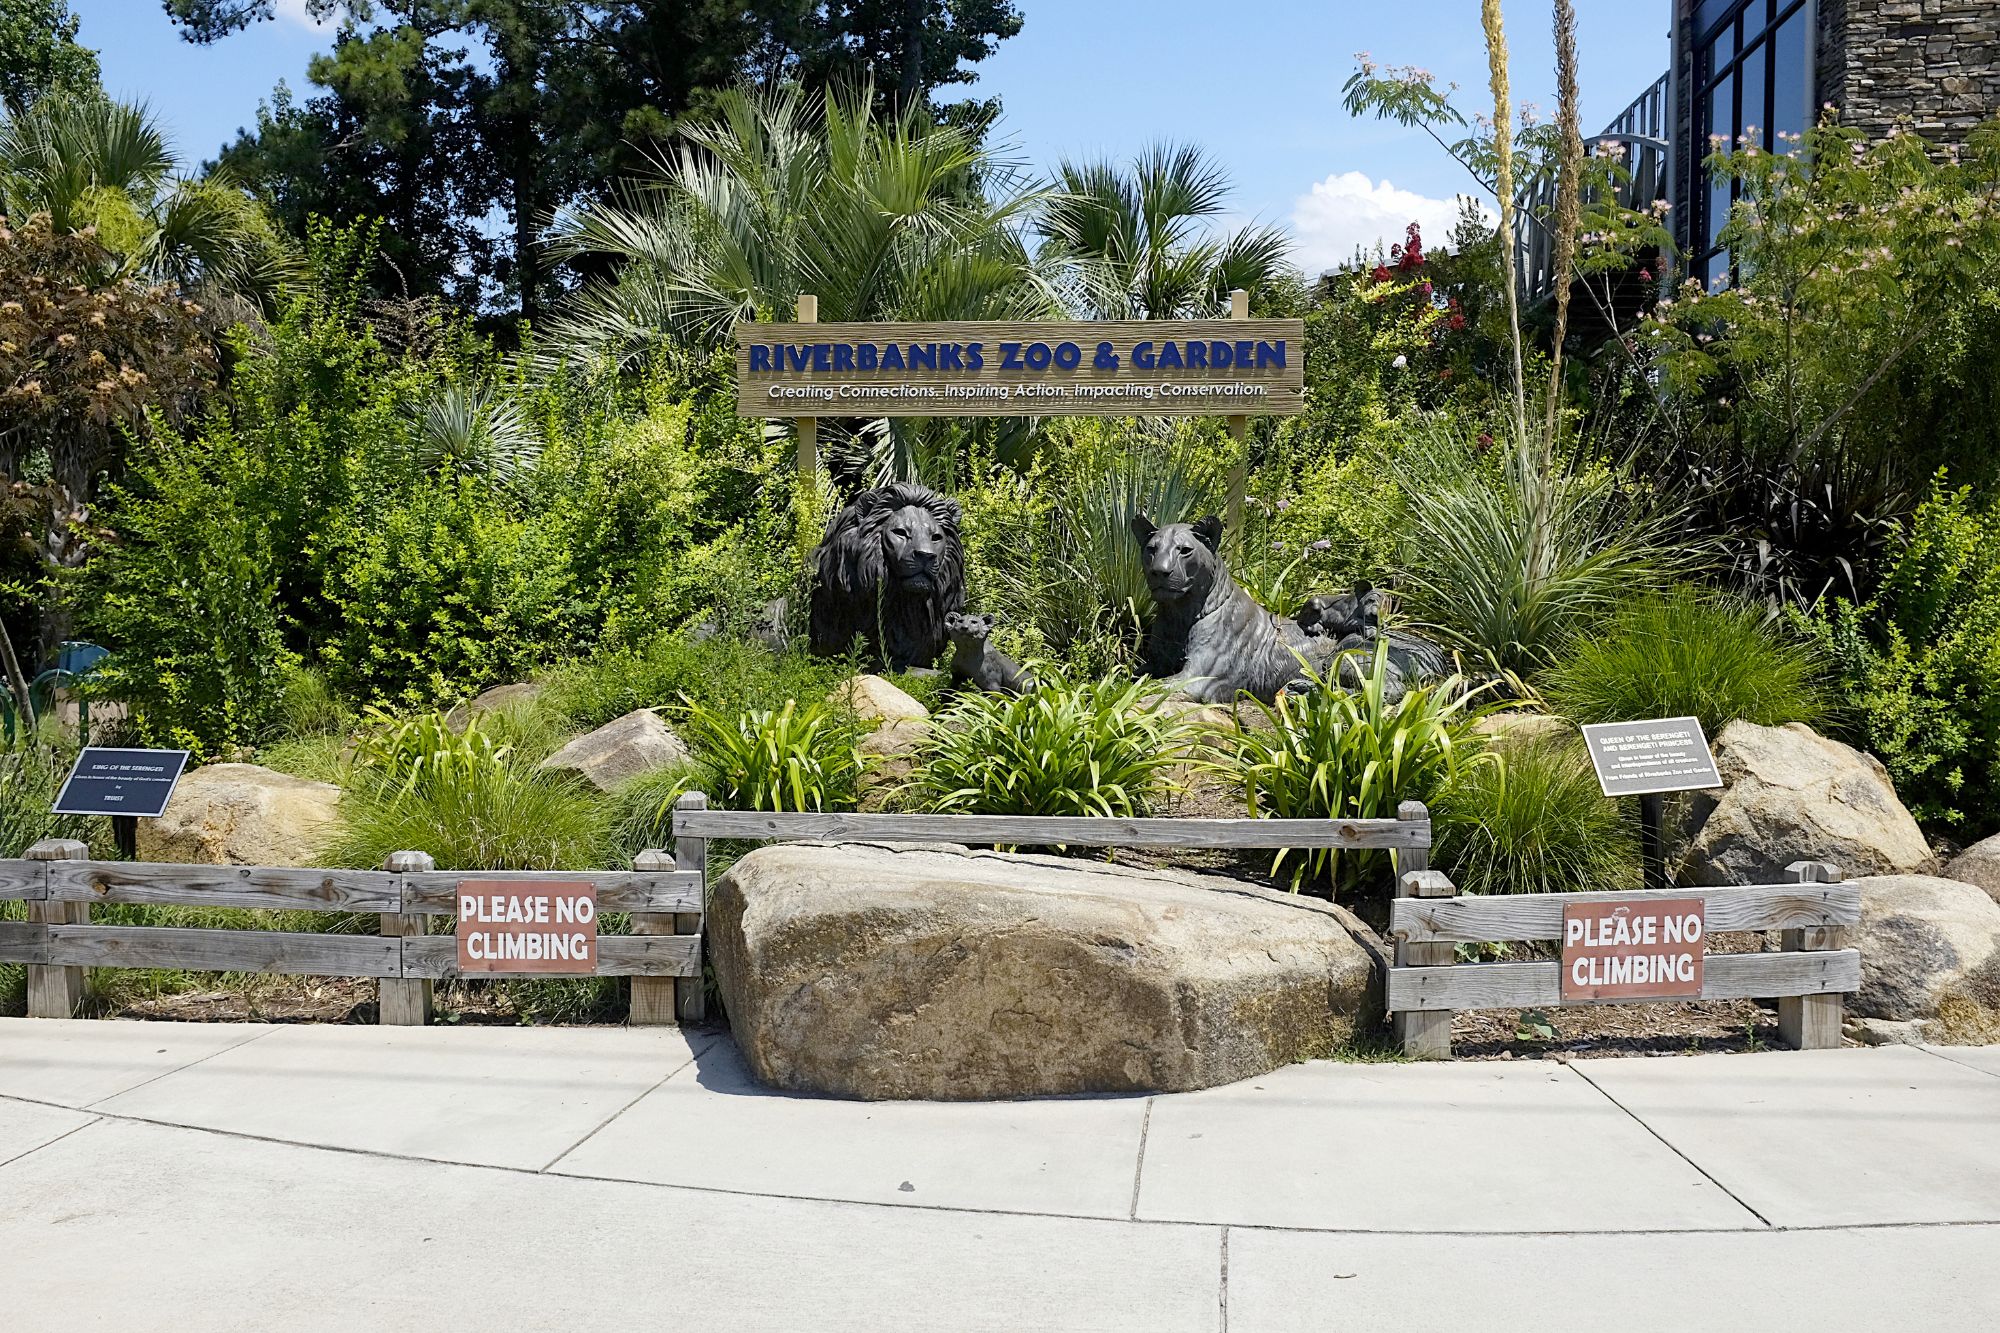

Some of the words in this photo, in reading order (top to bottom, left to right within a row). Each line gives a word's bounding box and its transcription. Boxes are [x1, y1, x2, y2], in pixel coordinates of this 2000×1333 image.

[749, 342, 984, 372] RIVERBANKS
[999, 341, 1082, 371] ZOO
[1093, 341, 1120, 371] &
[1131, 340, 1287, 370] GARDEN
[768, 384, 834, 401] Creating
[839, 383, 939, 398] Connections.
[944, 383, 1009, 399] Inspiring
[1014, 383, 1069, 397] Action.
[1074, 382, 1154, 399] Impacting
[1159, 382, 1268, 396] Conservation.
[1619, 742, 1658, 751] SERENGETI
[1658, 739, 1694, 748] PRINCESS
[1635, 734, 1651, 742] THE
[1651, 732, 1691, 740] SERENGETI
[460, 895, 550, 924] PLEASE
[555, 896, 594, 924] NO
[1567, 915, 1657, 947] PLEASE
[1663, 914, 1702, 944] NO
[467, 931, 588, 960] CLIMBING
[1572, 953, 1695, 986] CLIMBING
